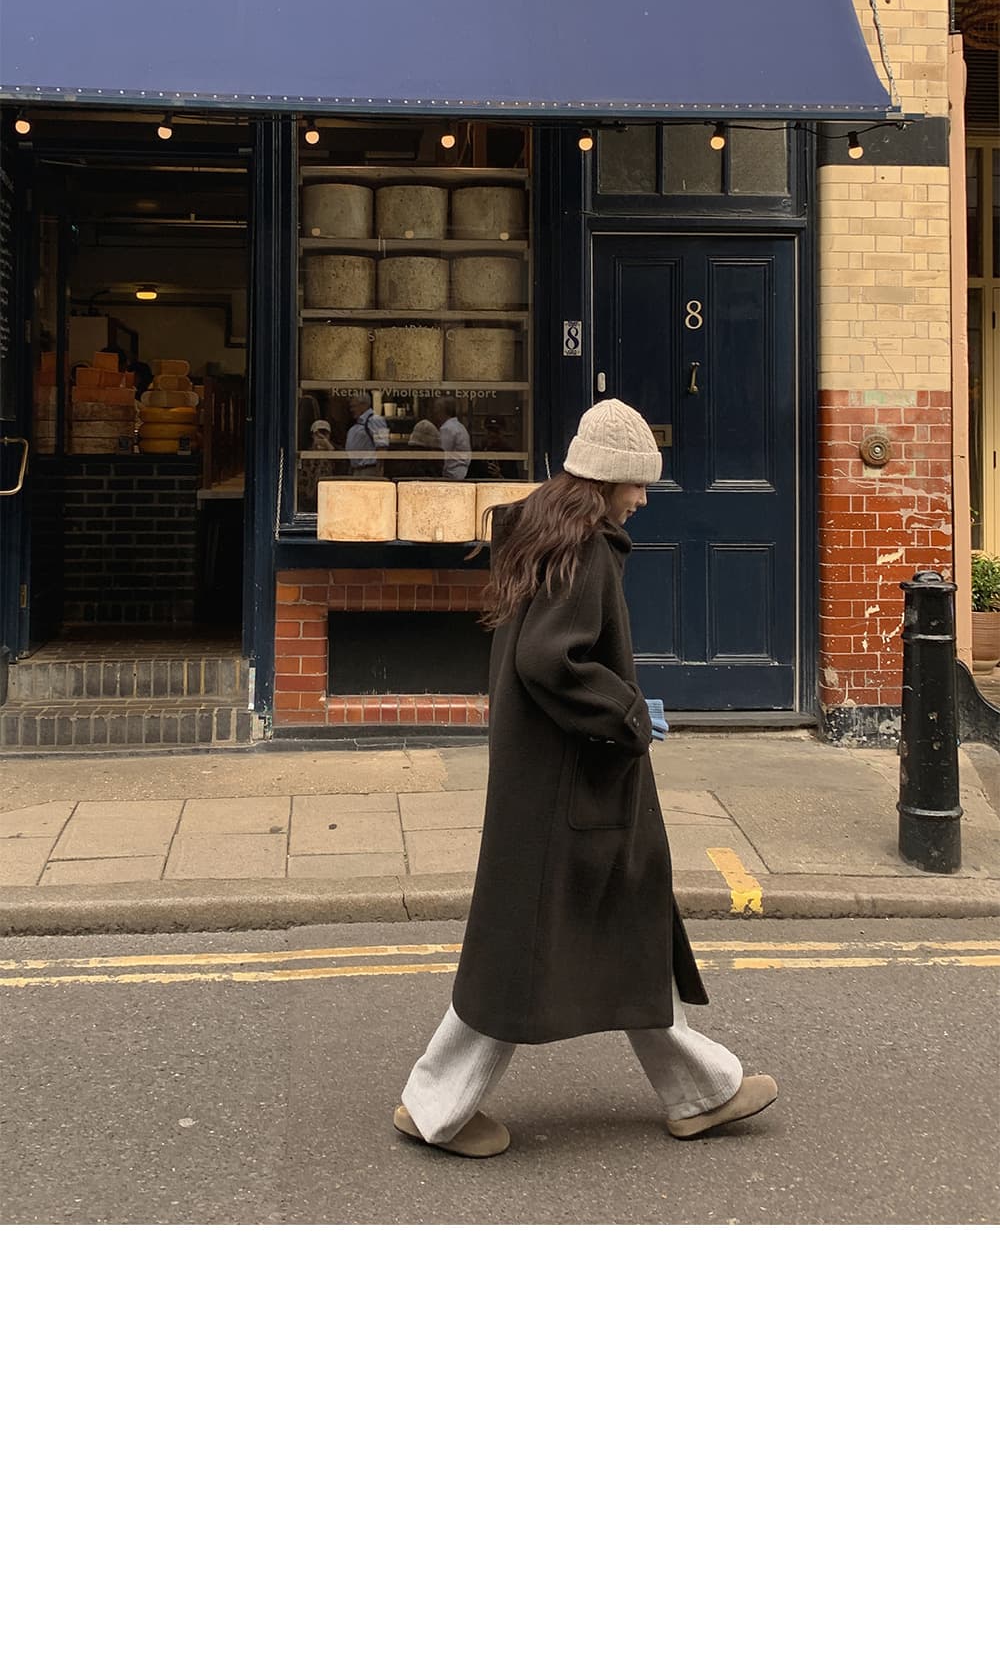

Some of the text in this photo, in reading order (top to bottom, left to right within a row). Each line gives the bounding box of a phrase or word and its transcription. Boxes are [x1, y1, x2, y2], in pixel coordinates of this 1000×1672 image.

[685, 300, 703, 330] 8
[565, 326, 580, 350] 8
[331, 387, 497, 401] Retail Wholesale Export
